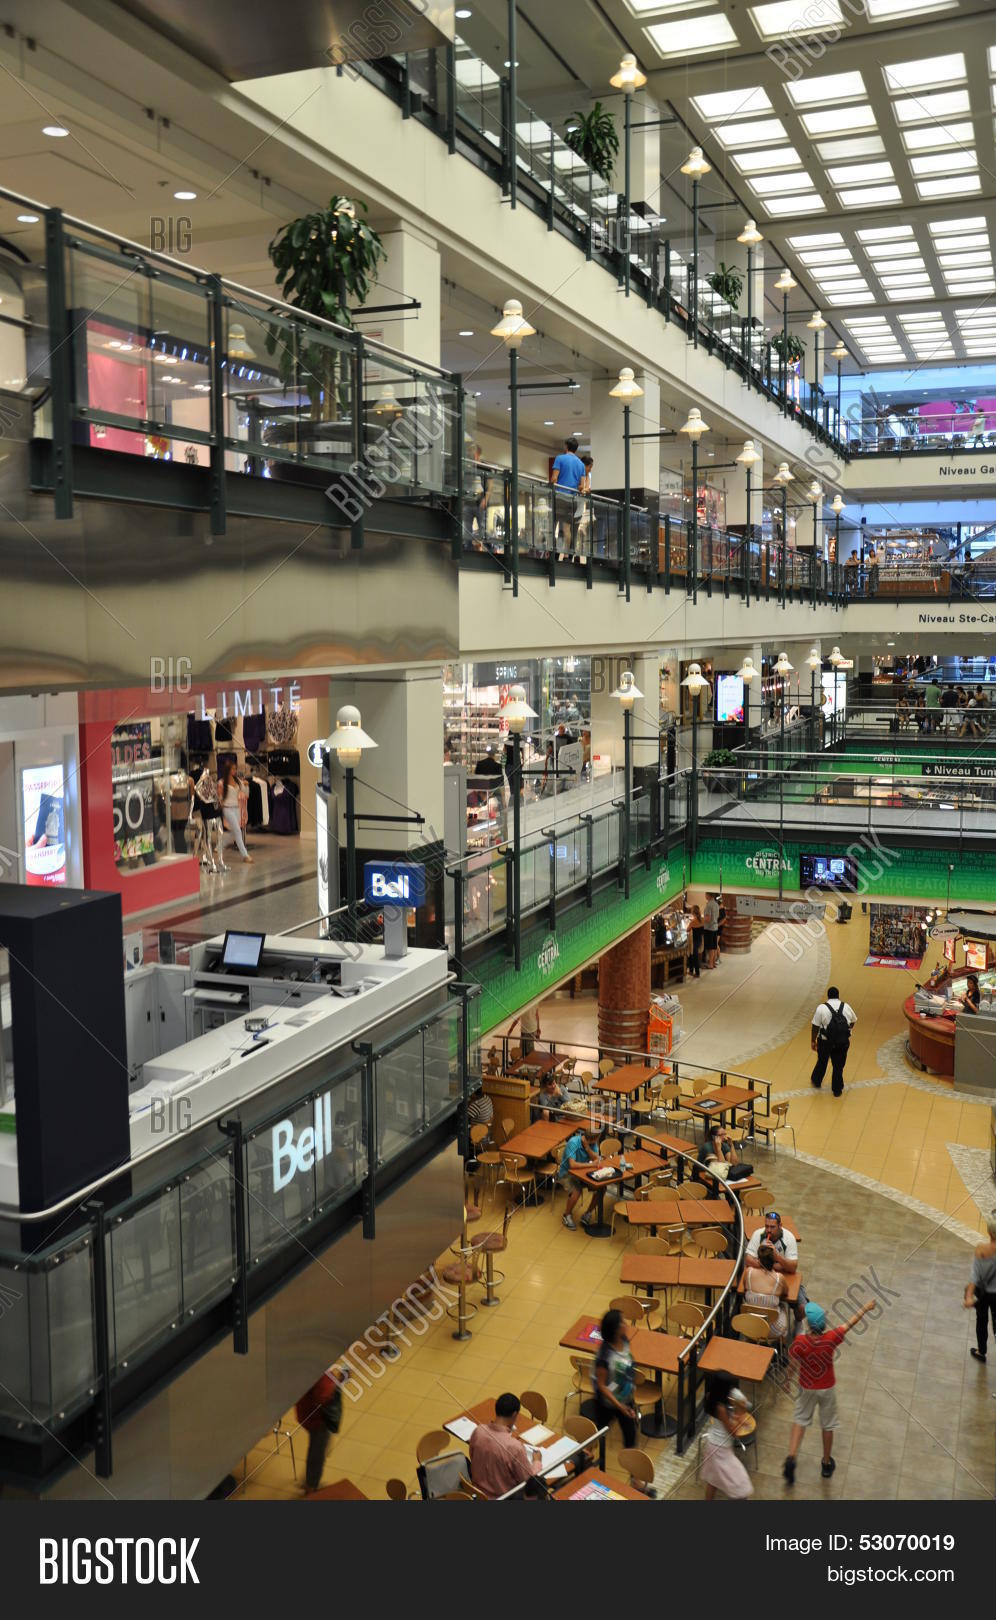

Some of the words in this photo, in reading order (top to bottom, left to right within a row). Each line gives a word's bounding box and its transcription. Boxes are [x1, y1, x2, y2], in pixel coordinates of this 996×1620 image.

[939, 466, 976, 476] Niveau
[980, 464, 996, 475] Ga
[918, 614, 955, 623] Niveau
[197, 680, 301, 721] LIMITÉ
[933, 765, 971, 775] Niveau
[745, 856, 793, 871] CENTRAL
[371, 872, 410, 899] Bell
[537, 943, 560, 969] CENTRAL
[272, 1091, 333, 1194] Bell
